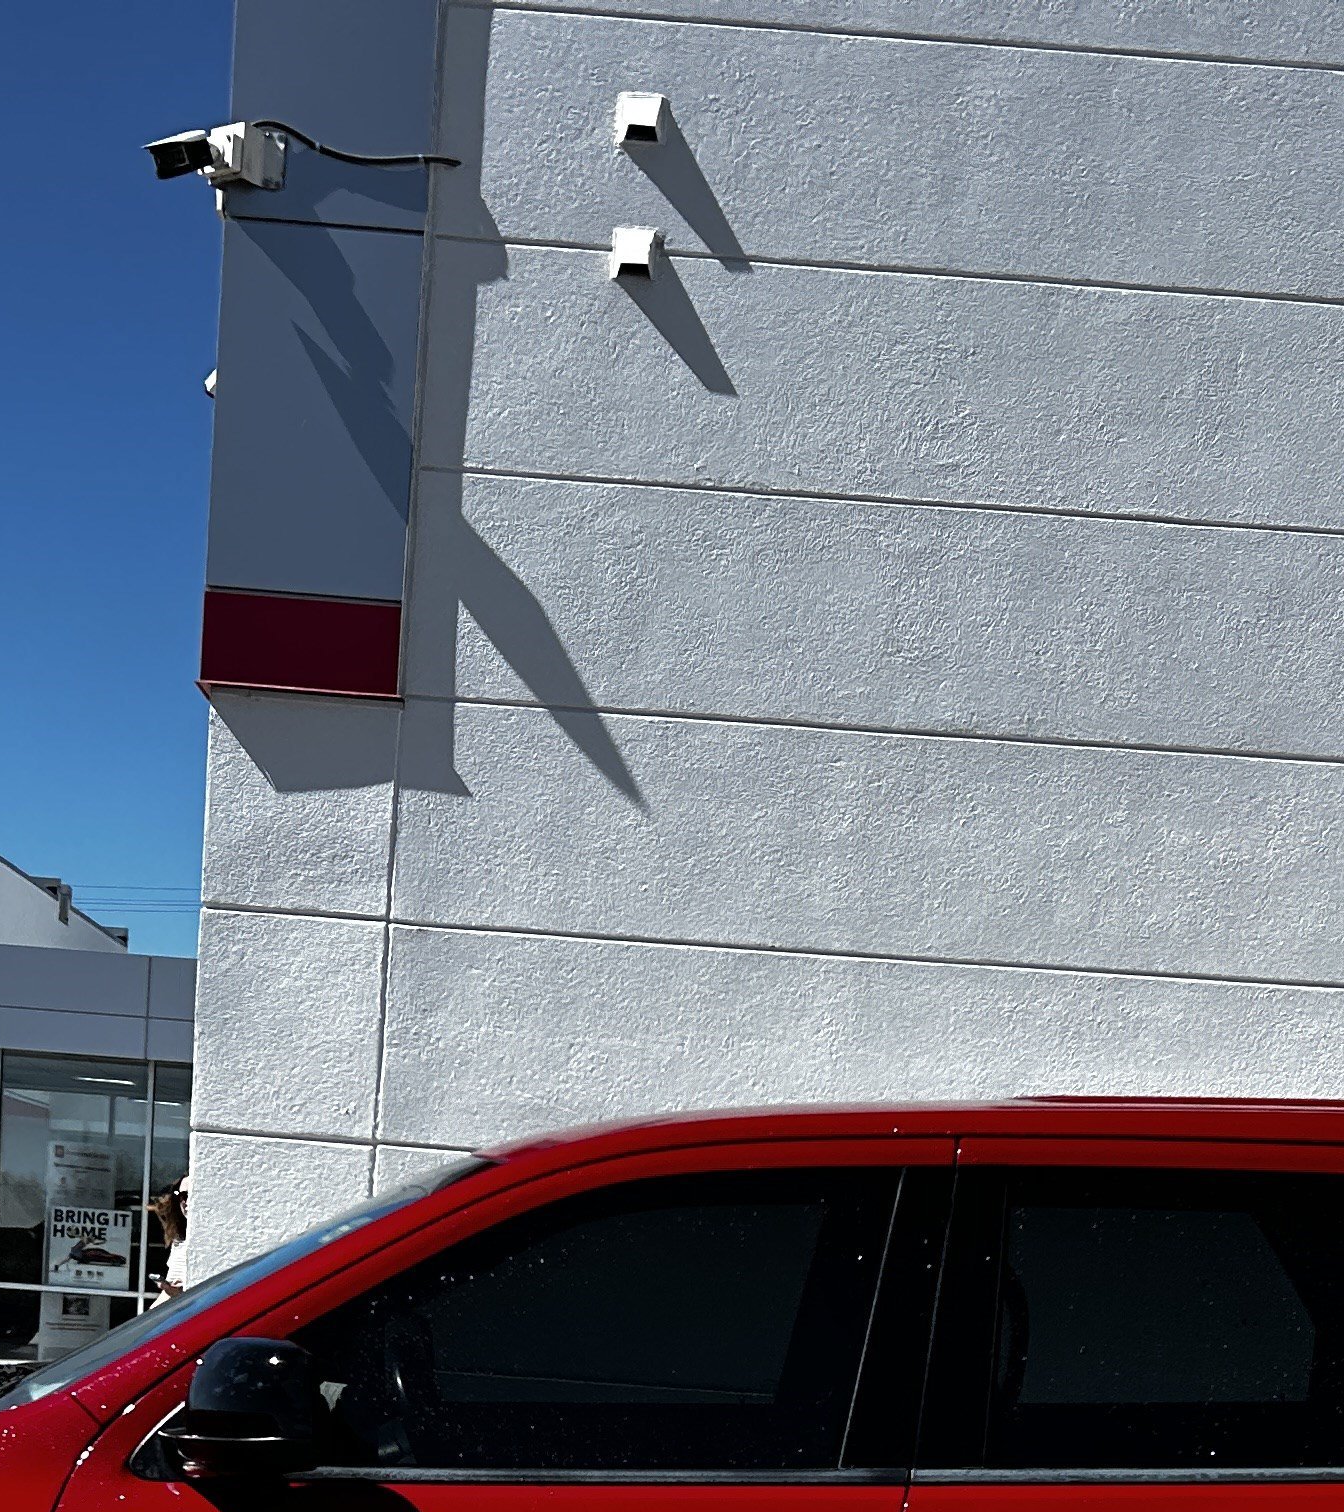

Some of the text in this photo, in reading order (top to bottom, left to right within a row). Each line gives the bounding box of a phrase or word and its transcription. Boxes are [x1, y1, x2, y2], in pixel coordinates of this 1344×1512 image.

[54, 1209, 130, 1227] BRING IT
[53, 1224, 107, 1240] HOME
